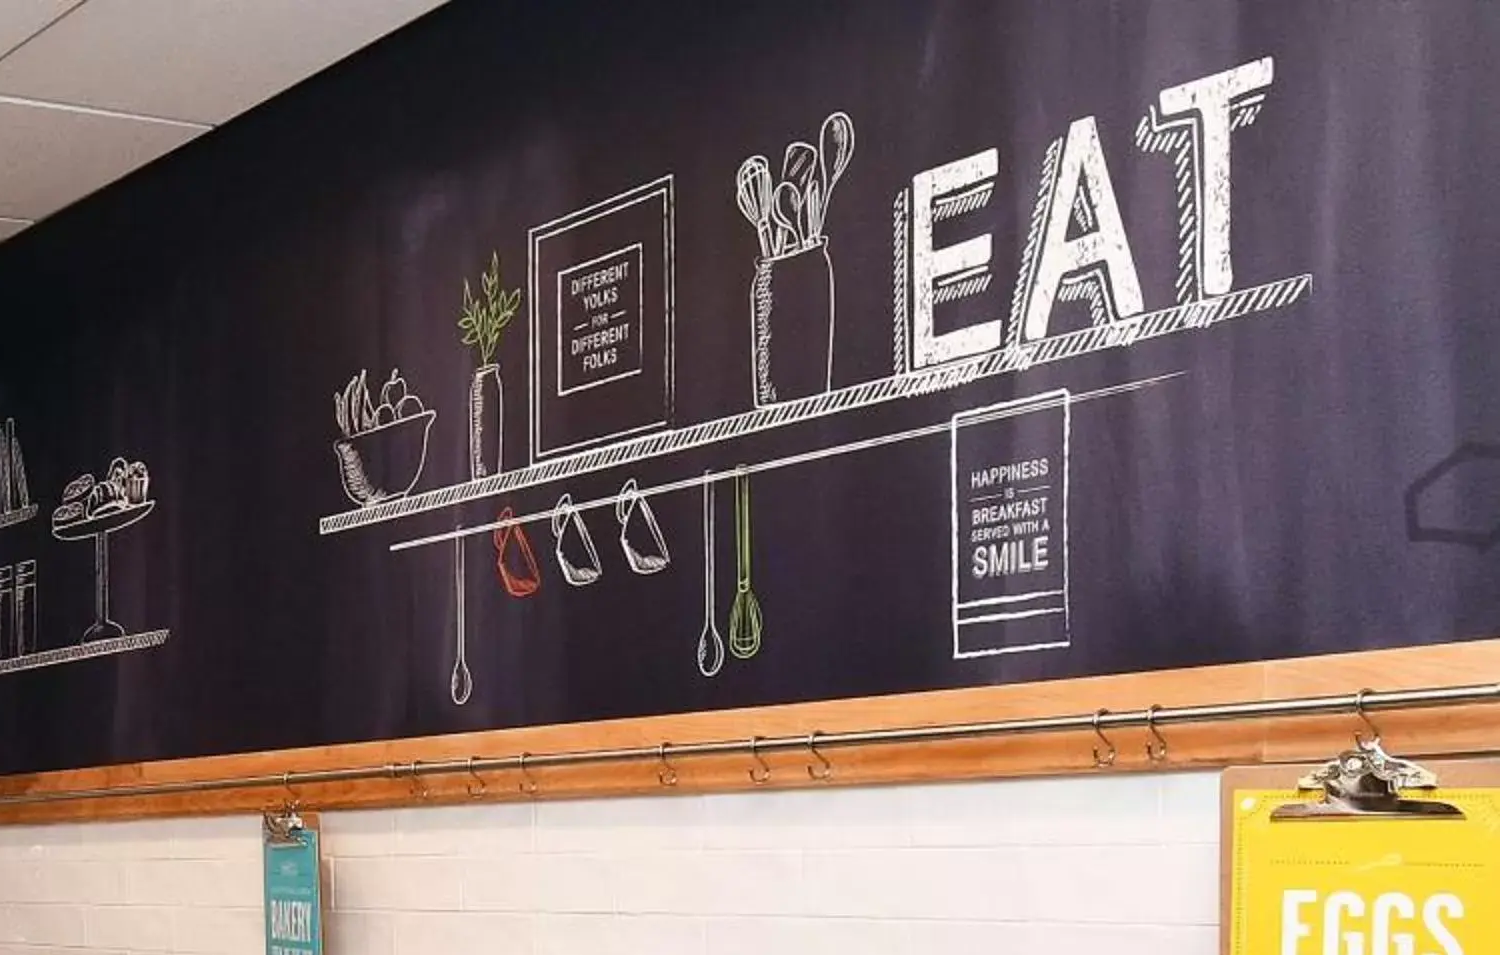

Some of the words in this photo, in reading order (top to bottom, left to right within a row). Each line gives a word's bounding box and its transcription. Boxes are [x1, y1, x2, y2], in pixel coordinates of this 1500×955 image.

[894, 56, 1274, 374] EAT
[571, 261, 629, 296] DIFFERENT
[583, 286, 618, 311] YOLKS
[571, 323, 629, 356] DIFFERENT
[583, 347, 617, 372] FOLKS
[971, 458, 1049, 489] HAPPINESS
[1004, 487, 1015, 499] IS
[972, 497, 1048, 526] BREAKFAST
[971, 525, 1010, 543] SERVED
[1013, 519, 1039, 535] WITH
[1041, 518, 1051, 532] A
[972, 535, 1049, 580] SMILE
[270, 898, 312, 943] BAKERY
